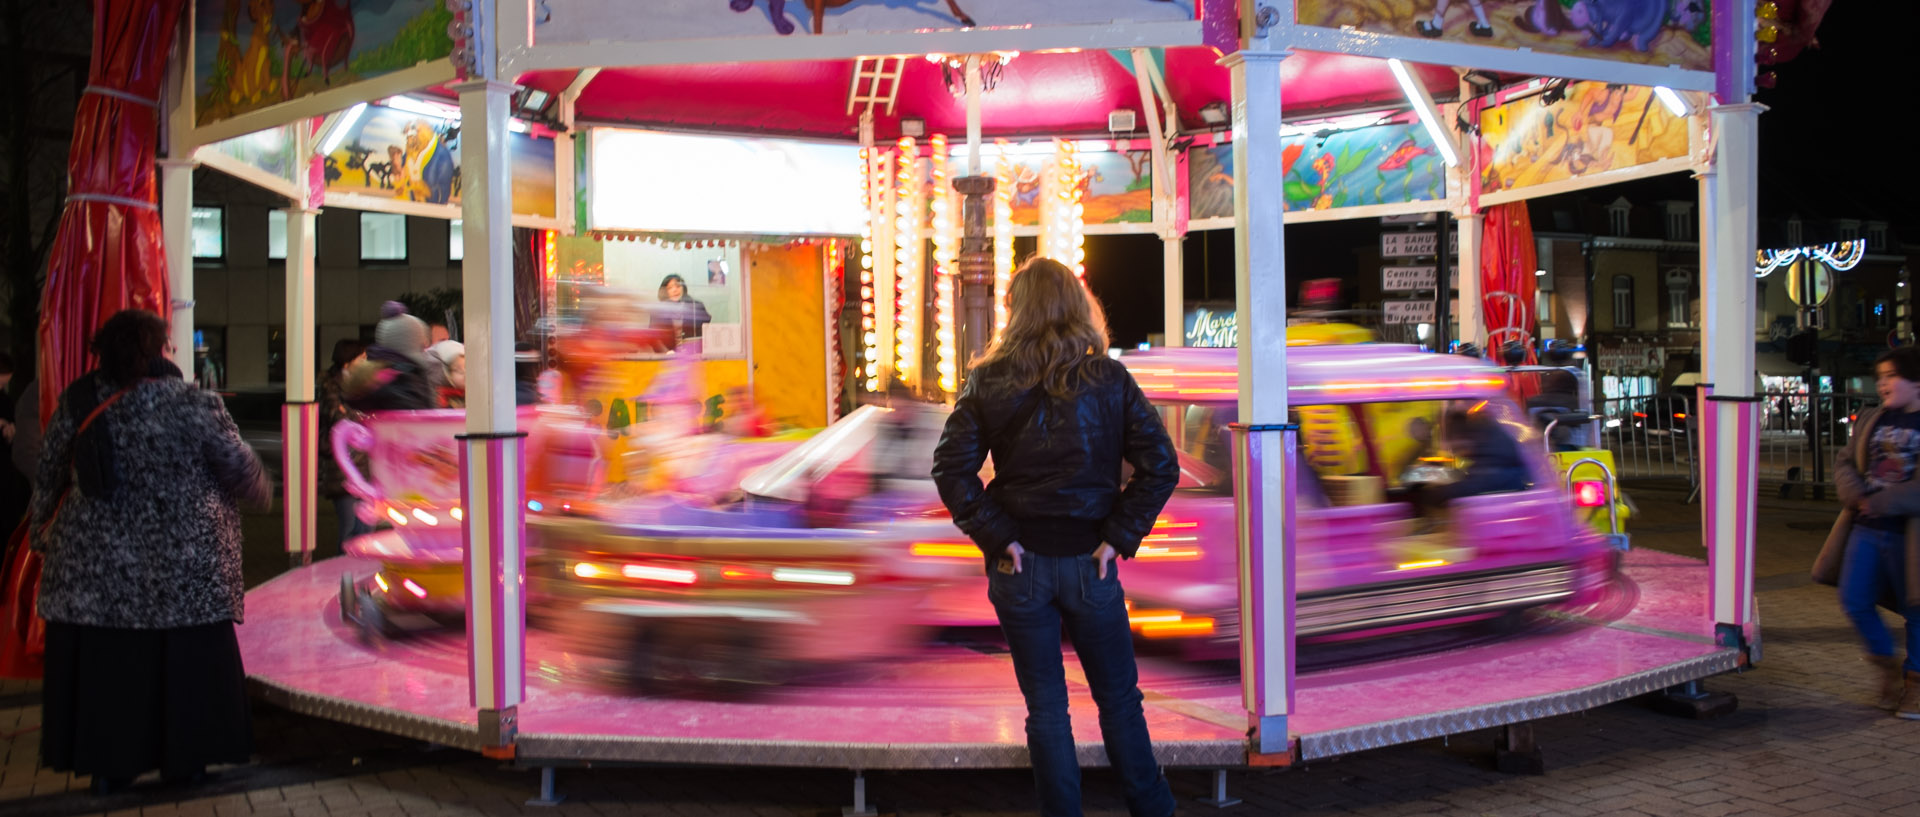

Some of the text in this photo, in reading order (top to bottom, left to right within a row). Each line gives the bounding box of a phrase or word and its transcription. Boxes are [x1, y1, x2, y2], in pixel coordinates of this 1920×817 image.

[1385, 236, 1398, 245] LA
[1385, 246, 1398, 255] LA
[1386, 270, 1419, 279] Centre
[1386, 280, 1437, 290] H.Seigneu
[1404, 303, 1431, 312] GARE
[1186, 309, 1238, 339] Marc
